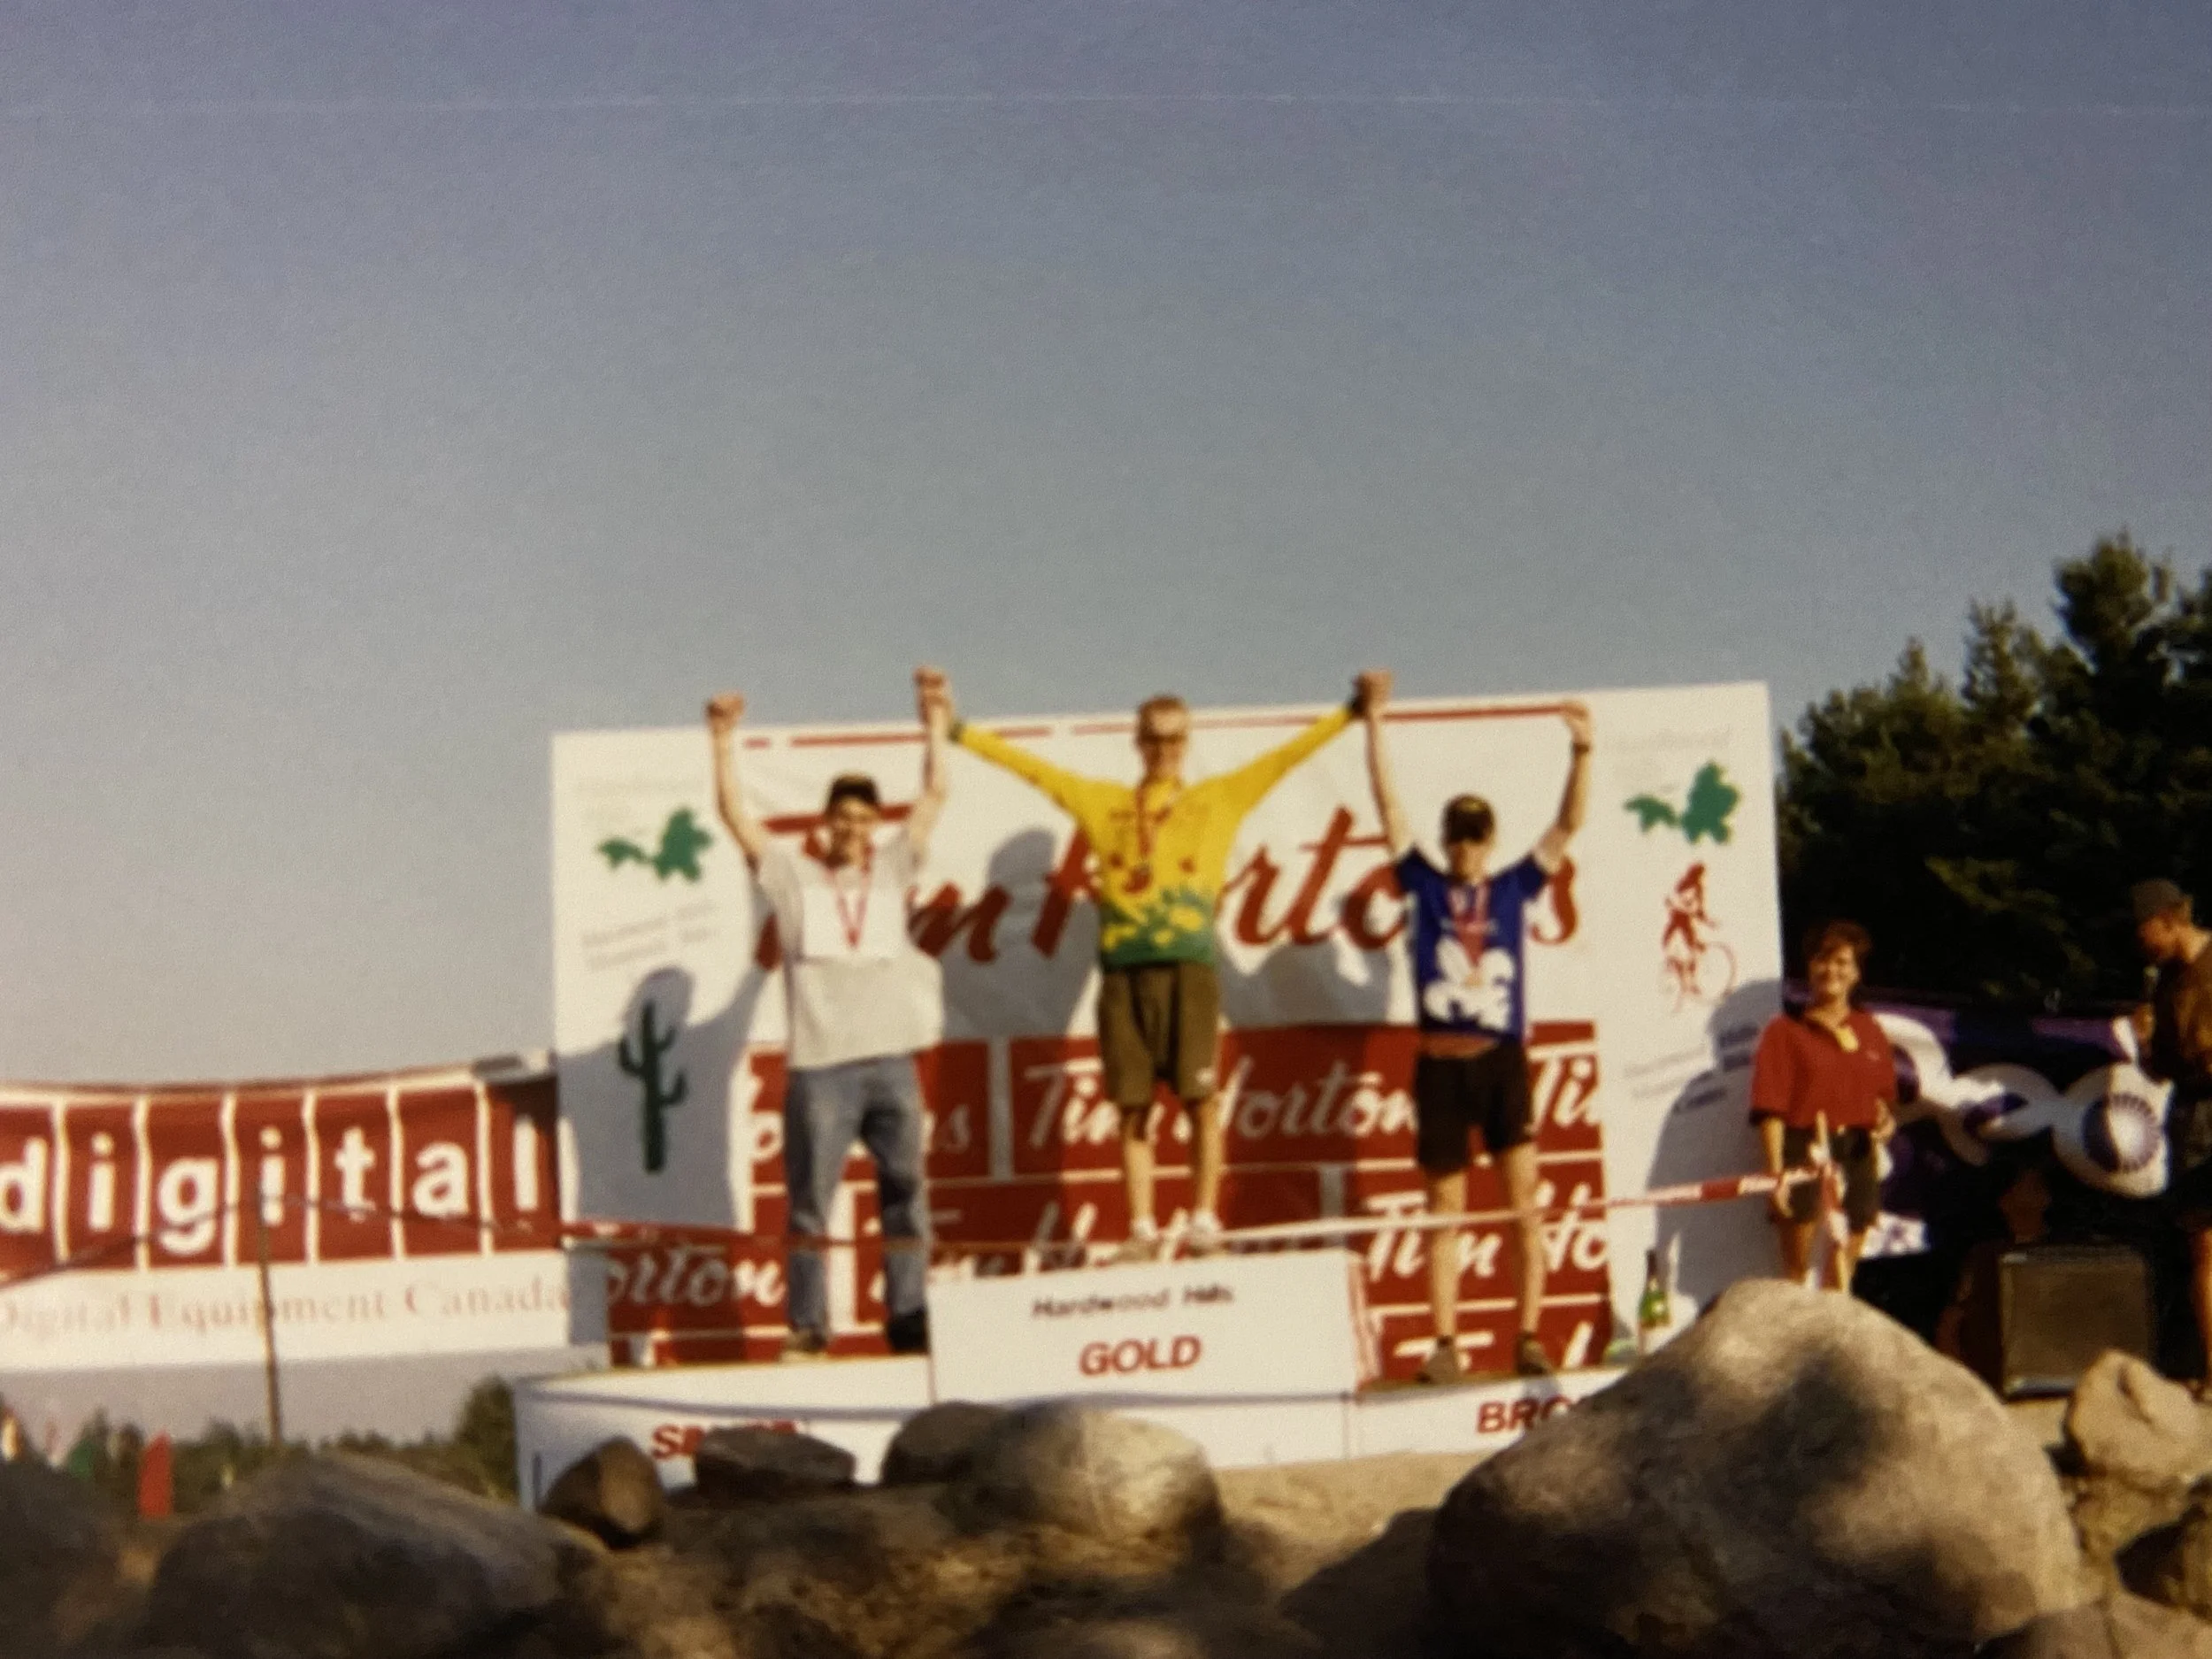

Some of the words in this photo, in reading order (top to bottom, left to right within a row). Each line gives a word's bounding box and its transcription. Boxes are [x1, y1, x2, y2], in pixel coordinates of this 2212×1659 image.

[0, 1124, 540, 1256] digital
[403, 1275, 571, 1316] Canada
[1032, 1286, 1171, 1319] Hardwood
[1078, 1333, 1204, 1377] GOLD
[1476, 1394, 1574, 1434] BRO
